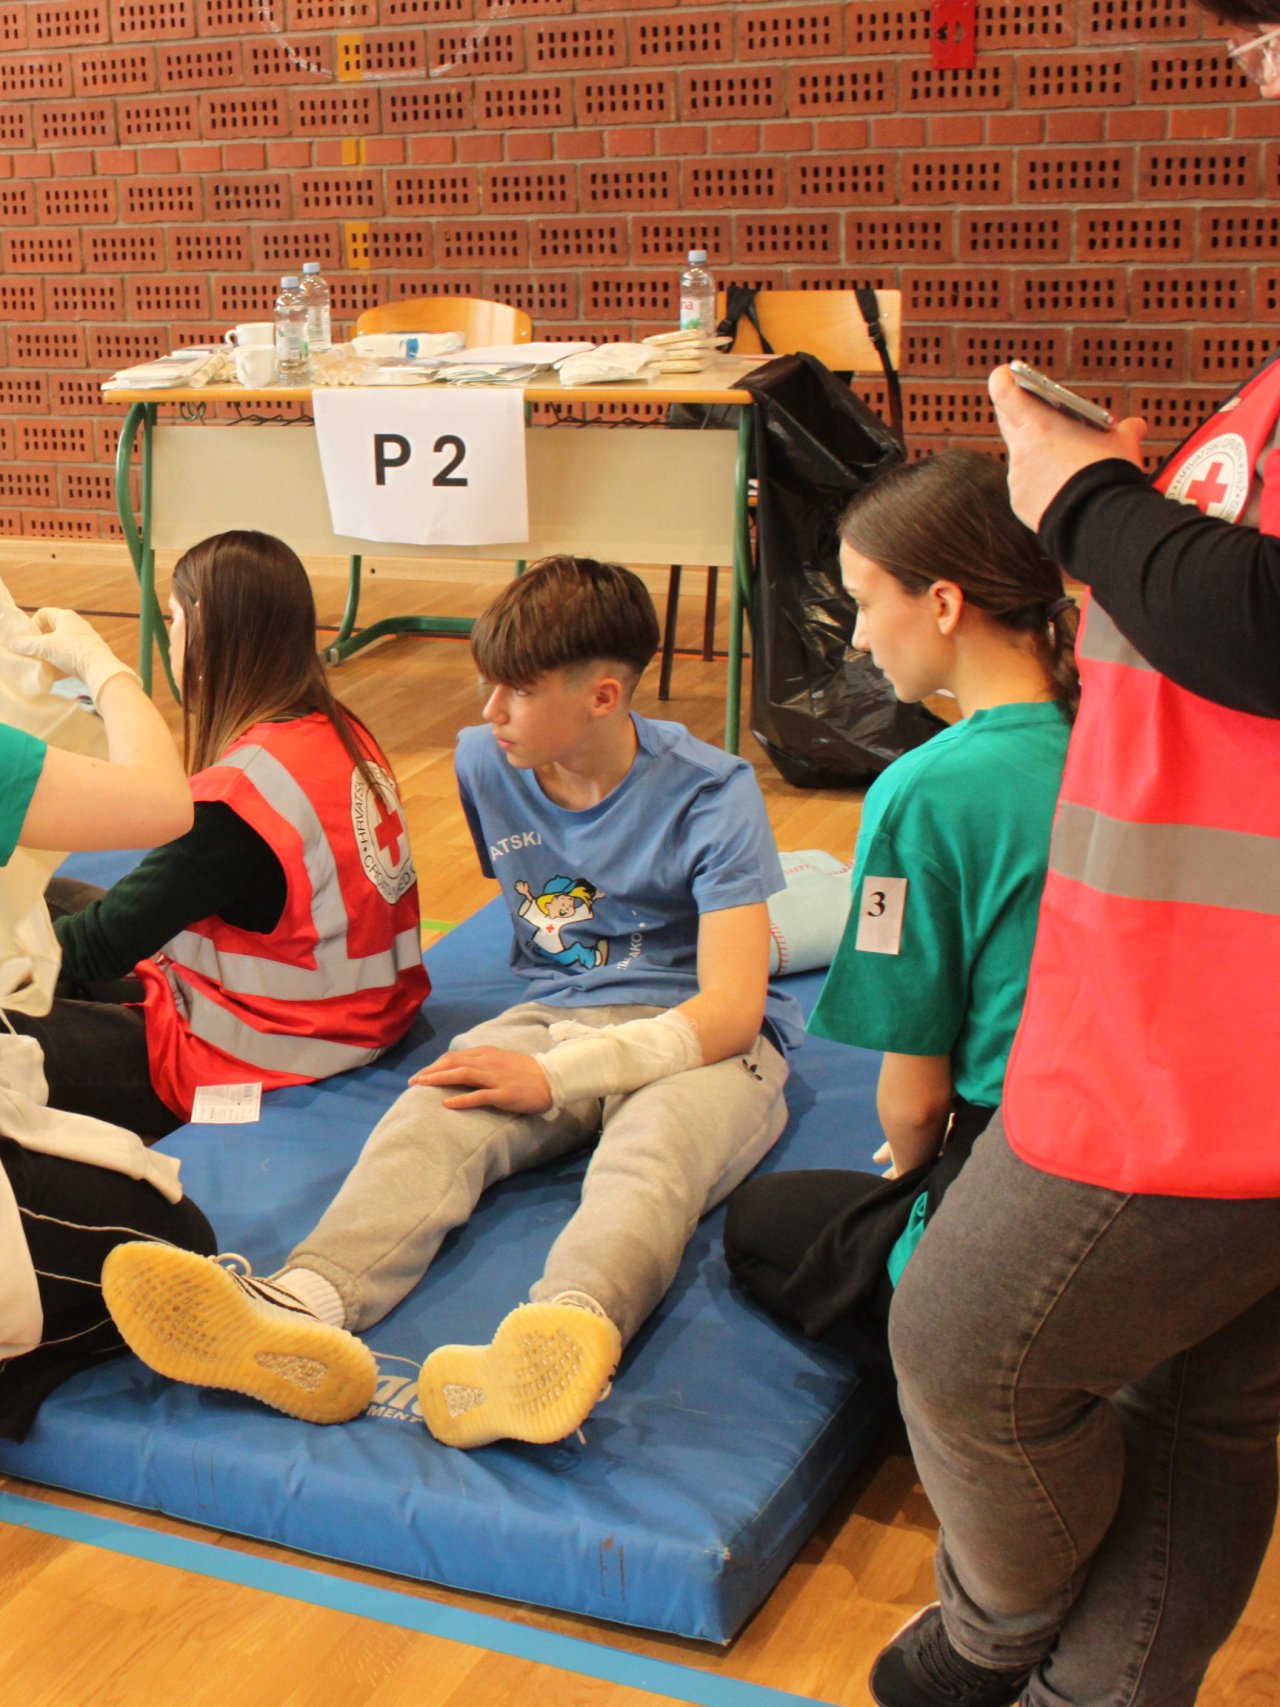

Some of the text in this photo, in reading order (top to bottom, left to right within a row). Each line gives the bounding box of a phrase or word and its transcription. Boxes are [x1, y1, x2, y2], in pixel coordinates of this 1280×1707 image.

[374, 433, 468, 487] P 2
[489, 831, 542, 861] ATSKI
[867, 891, 886, 918] 3
